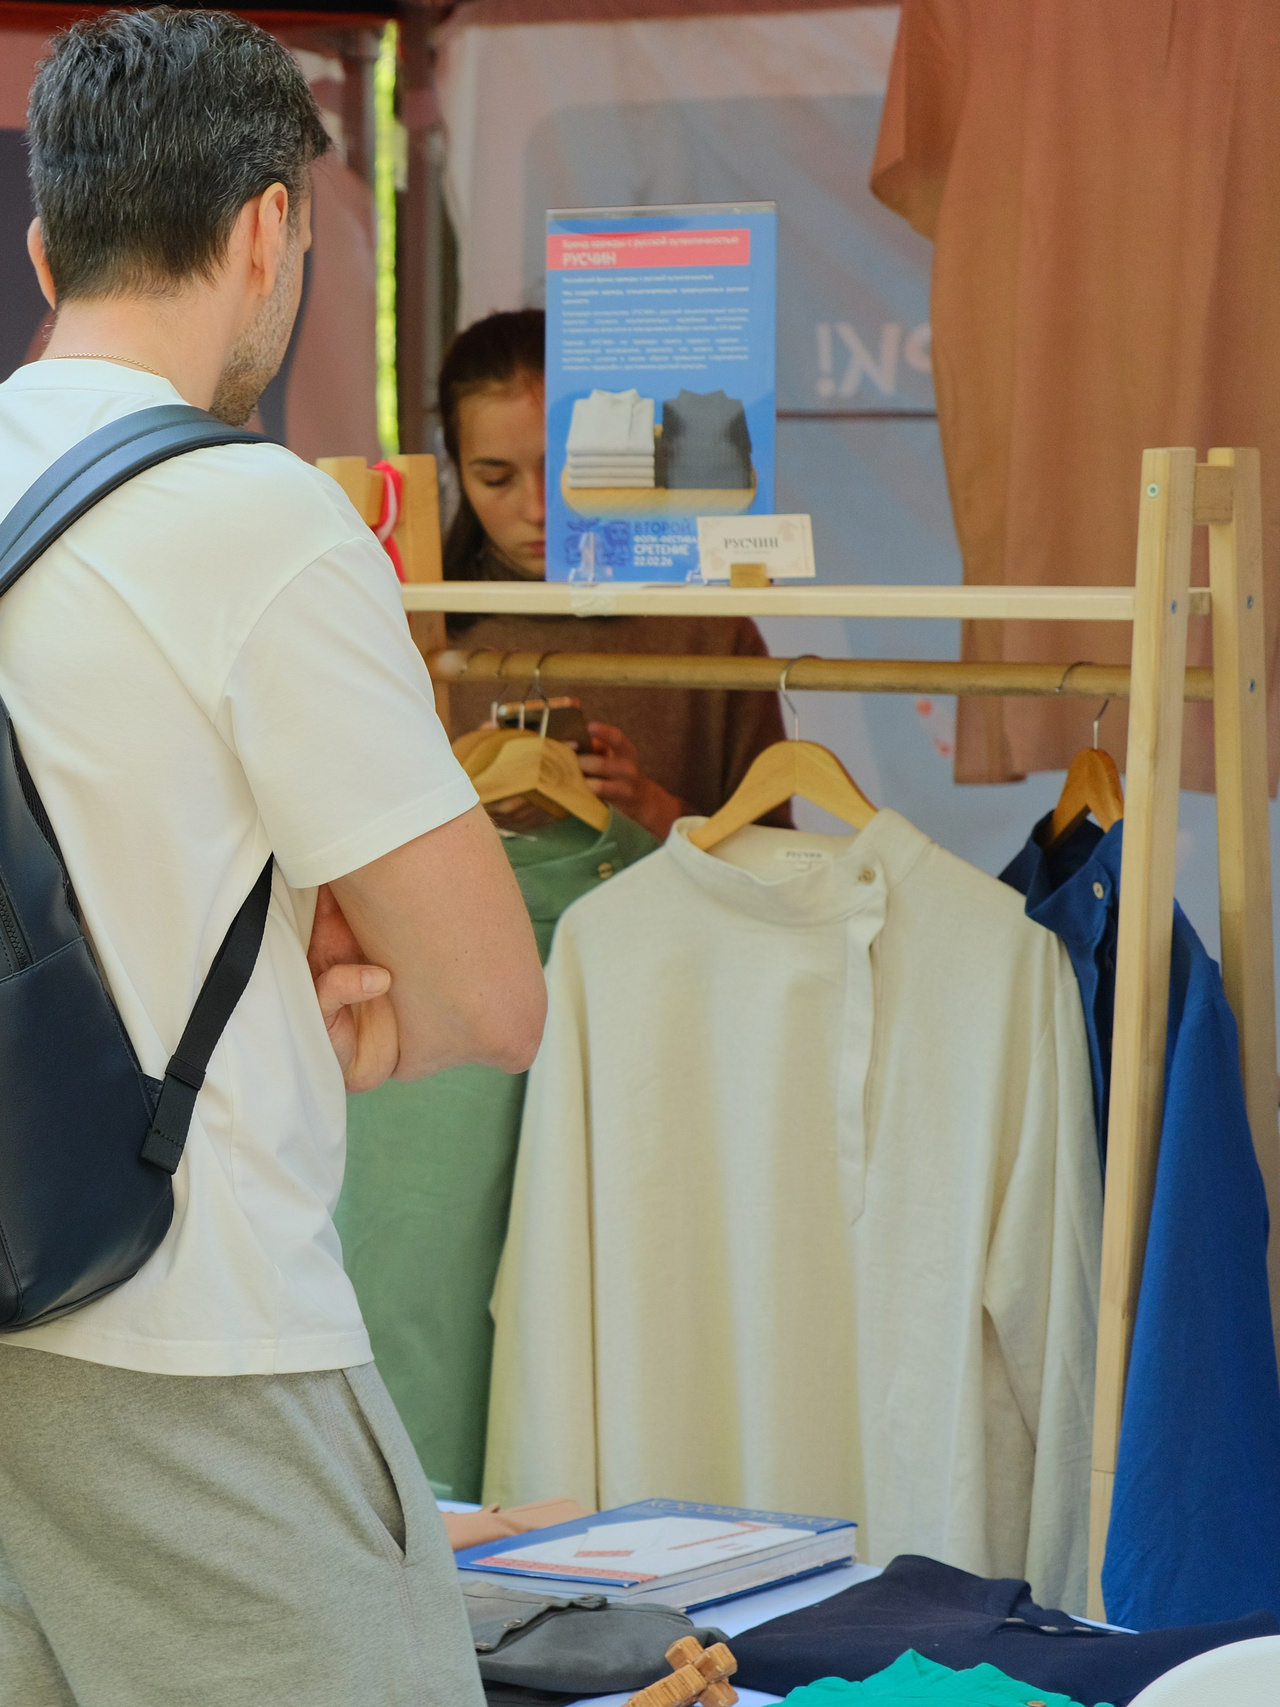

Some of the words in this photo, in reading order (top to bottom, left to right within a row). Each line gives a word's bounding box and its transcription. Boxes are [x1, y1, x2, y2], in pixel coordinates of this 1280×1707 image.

[562, 251, 617, 266] РУСЧИН
[634, 517, 690, 534] ВТОРОЙ
[633, 534, 697, 544] ФОЛК-ФЕСТИВА
[723, 537, 779, 550] РУСЧИН
[634, 544, 689, 556] СРЕТЕНИЕ
